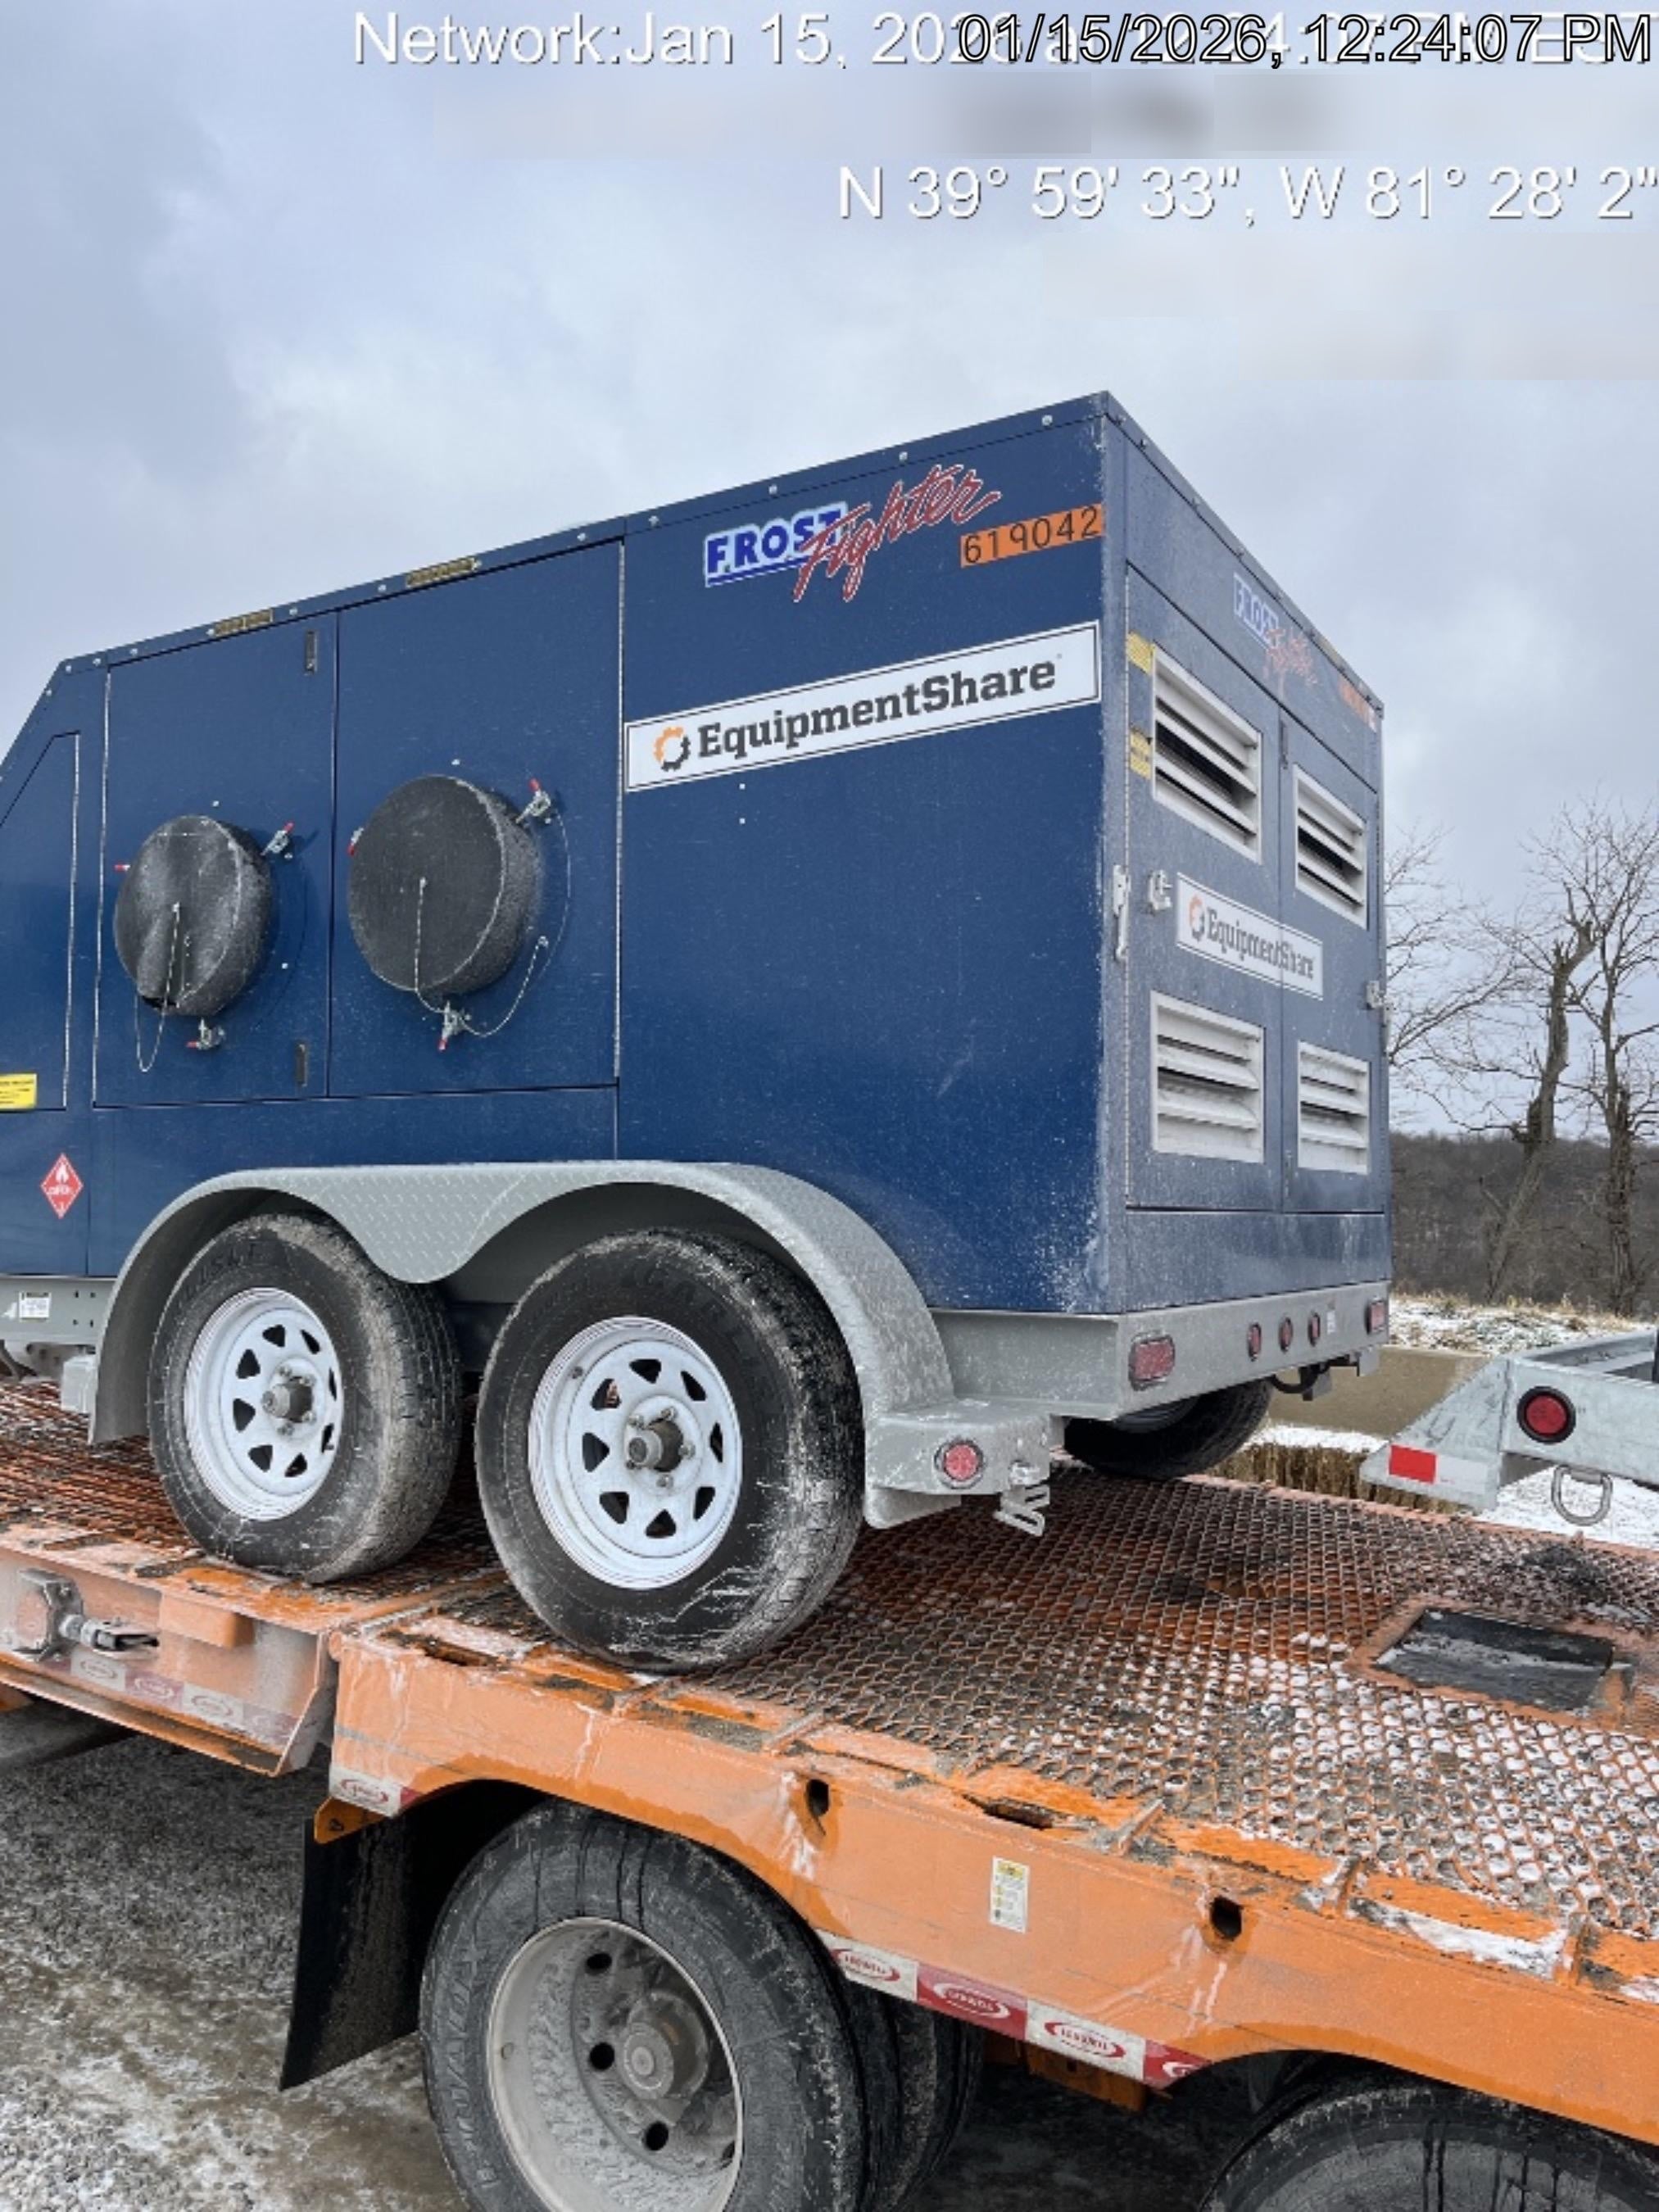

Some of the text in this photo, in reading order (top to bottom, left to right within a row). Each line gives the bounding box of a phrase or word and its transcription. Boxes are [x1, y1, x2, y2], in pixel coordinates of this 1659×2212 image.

[793, 464, 1003, 603] Fighter
[963, 505, 1099, 565] 619042
[697, 659, 1057, 760] EquipmentShare
[1207, 905, 1315, 979] EquipmentShare
